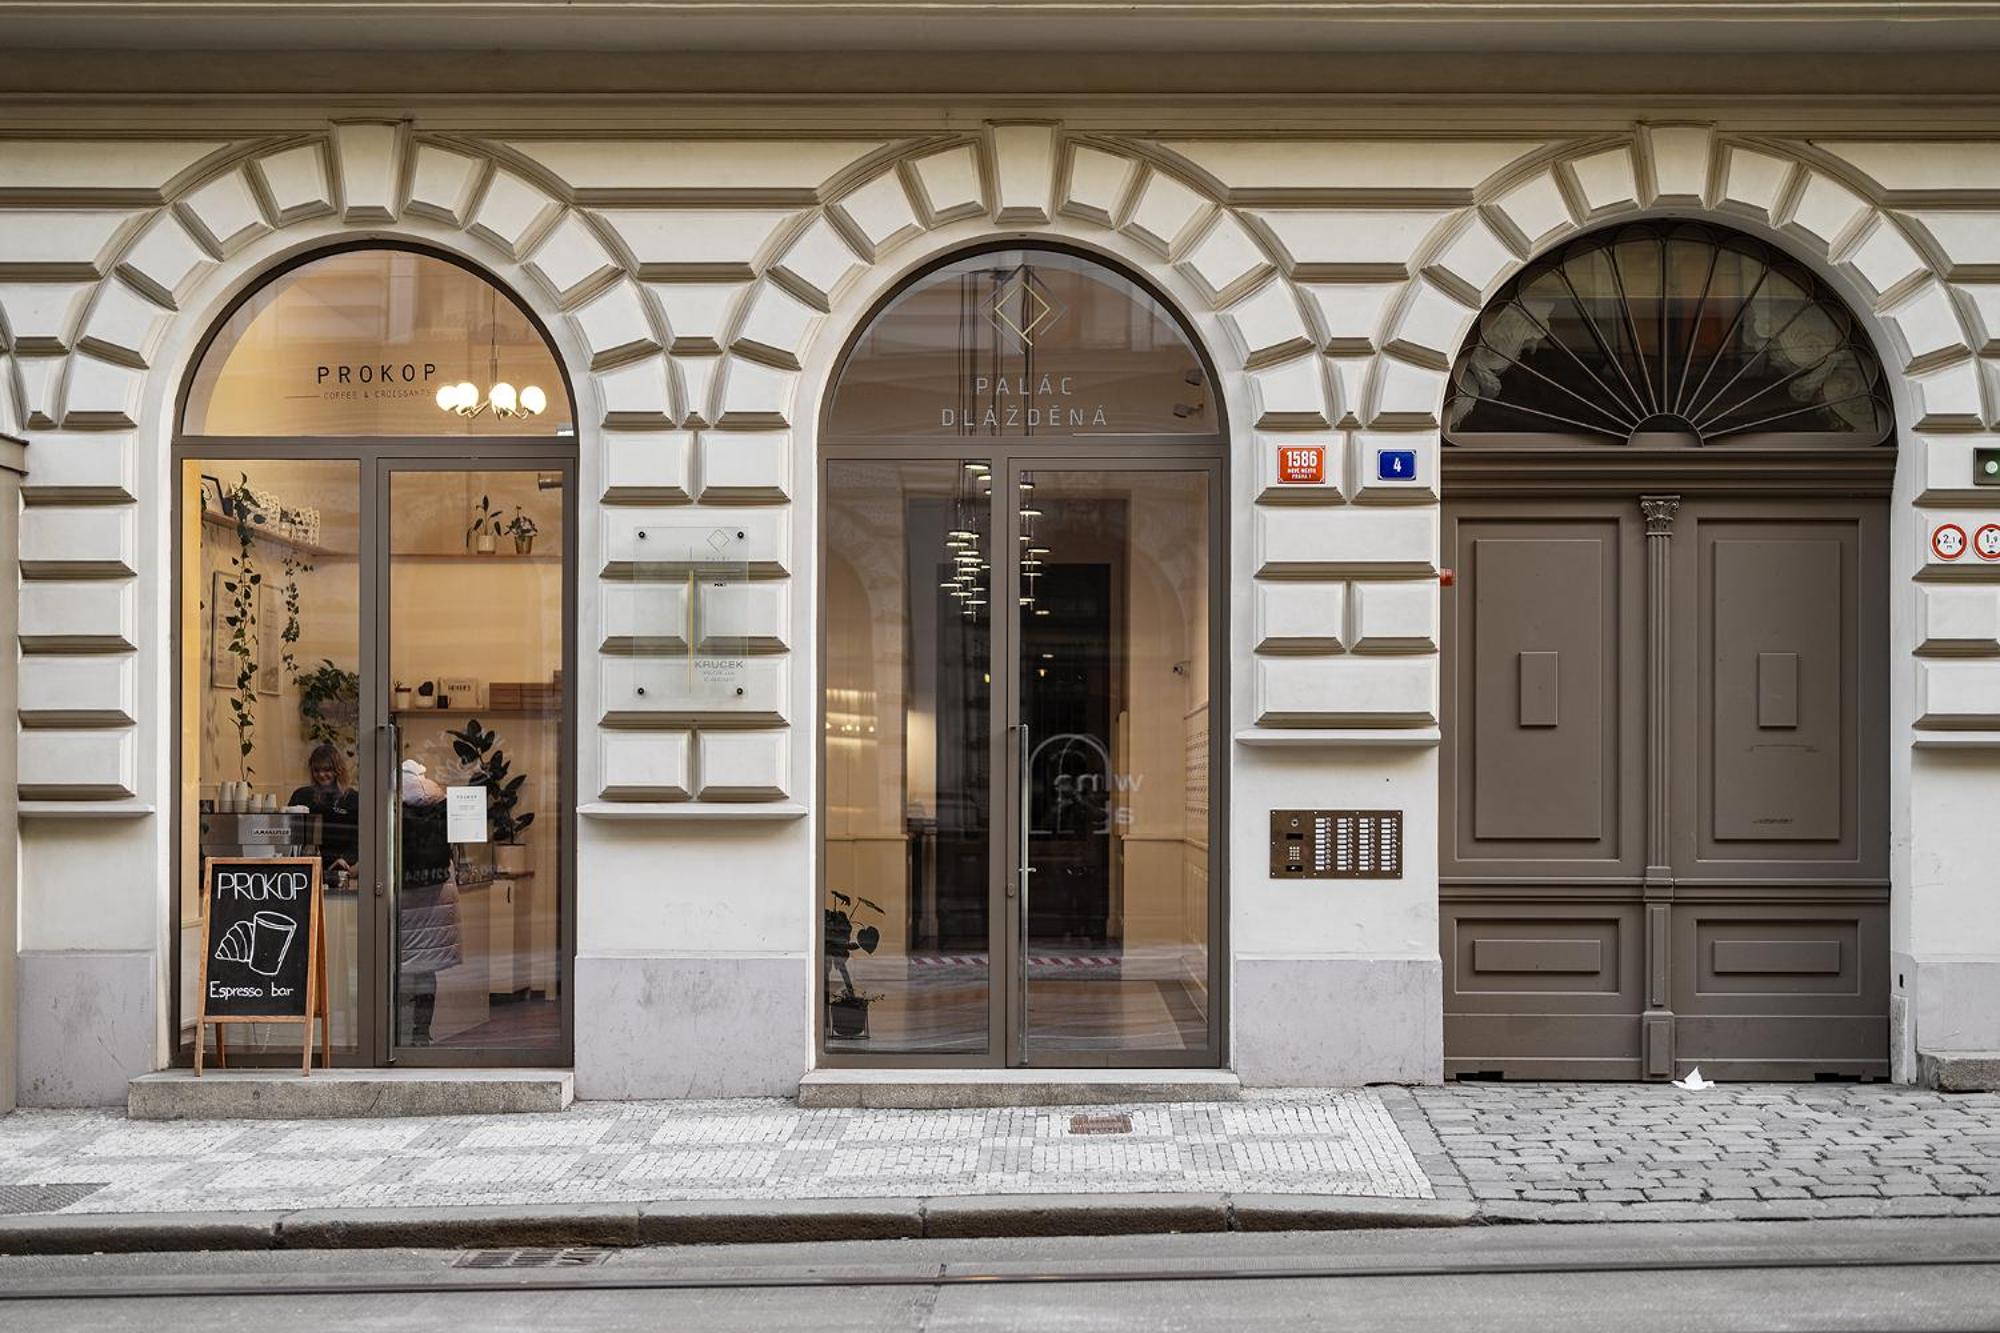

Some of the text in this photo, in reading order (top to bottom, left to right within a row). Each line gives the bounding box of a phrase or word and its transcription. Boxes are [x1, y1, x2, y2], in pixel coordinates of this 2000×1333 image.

[317, 363, 436, 384] PROKOP
[976, 374, 1073, 396] PALÁC
[942, 404, 1107, 426] DLÁŽDĚNÁ
[1286, 451, 1318, 467] 1586
[1393, 457, 1401, 472] 4
[217, 873, 308, 901] PROKOP
[209, 981, 295, 1000] Espresso bar
